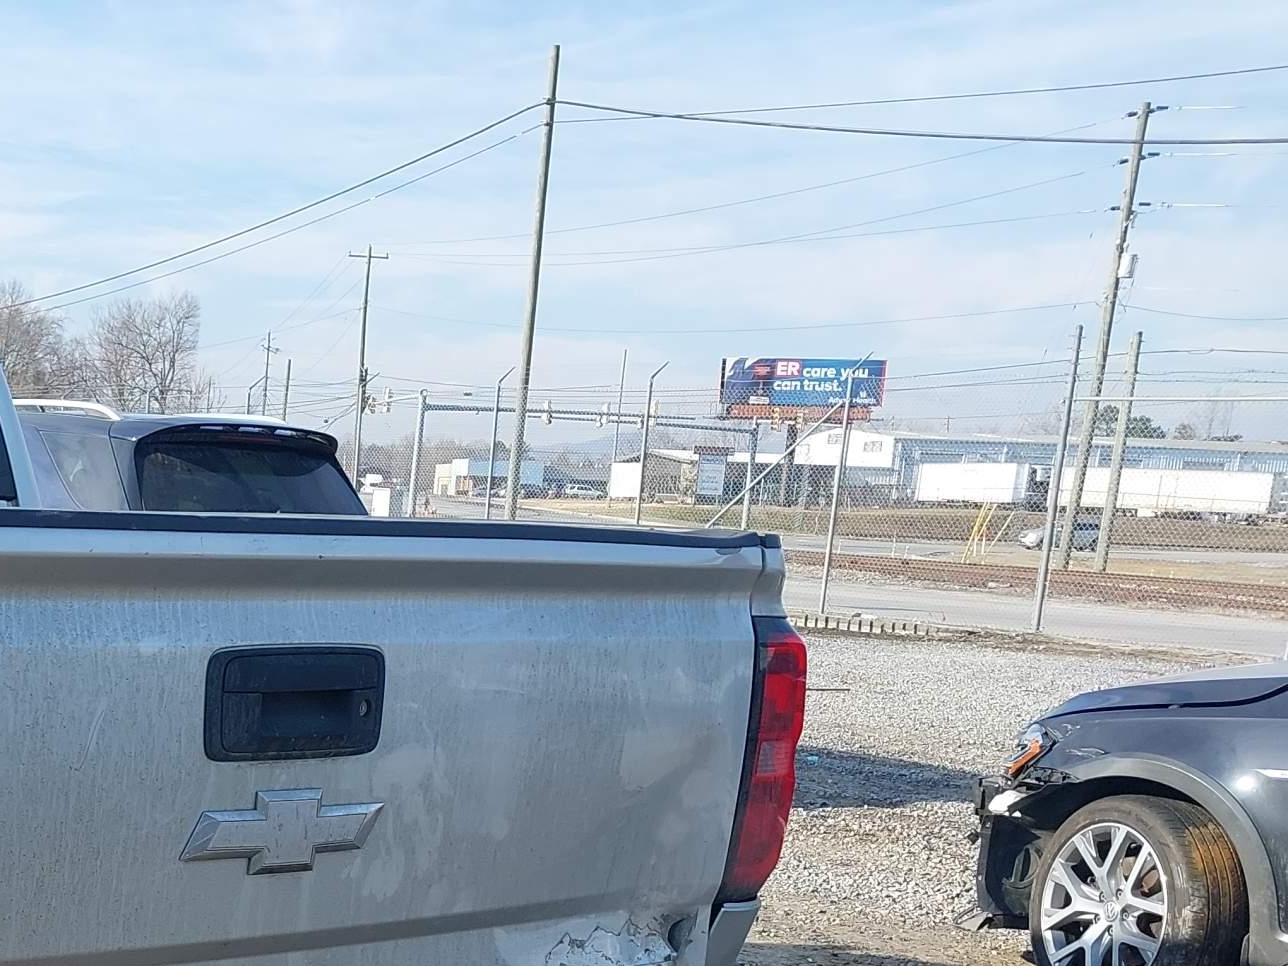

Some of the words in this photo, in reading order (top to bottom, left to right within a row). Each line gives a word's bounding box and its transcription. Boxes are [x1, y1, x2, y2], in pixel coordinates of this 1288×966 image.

[776, 361, 800, 376] ER
[802, 366, 837, 378] care
[840, 367, 869, 380] you
[773, 380, 801, 391] can
[803, 380, 843, 392] trust.
